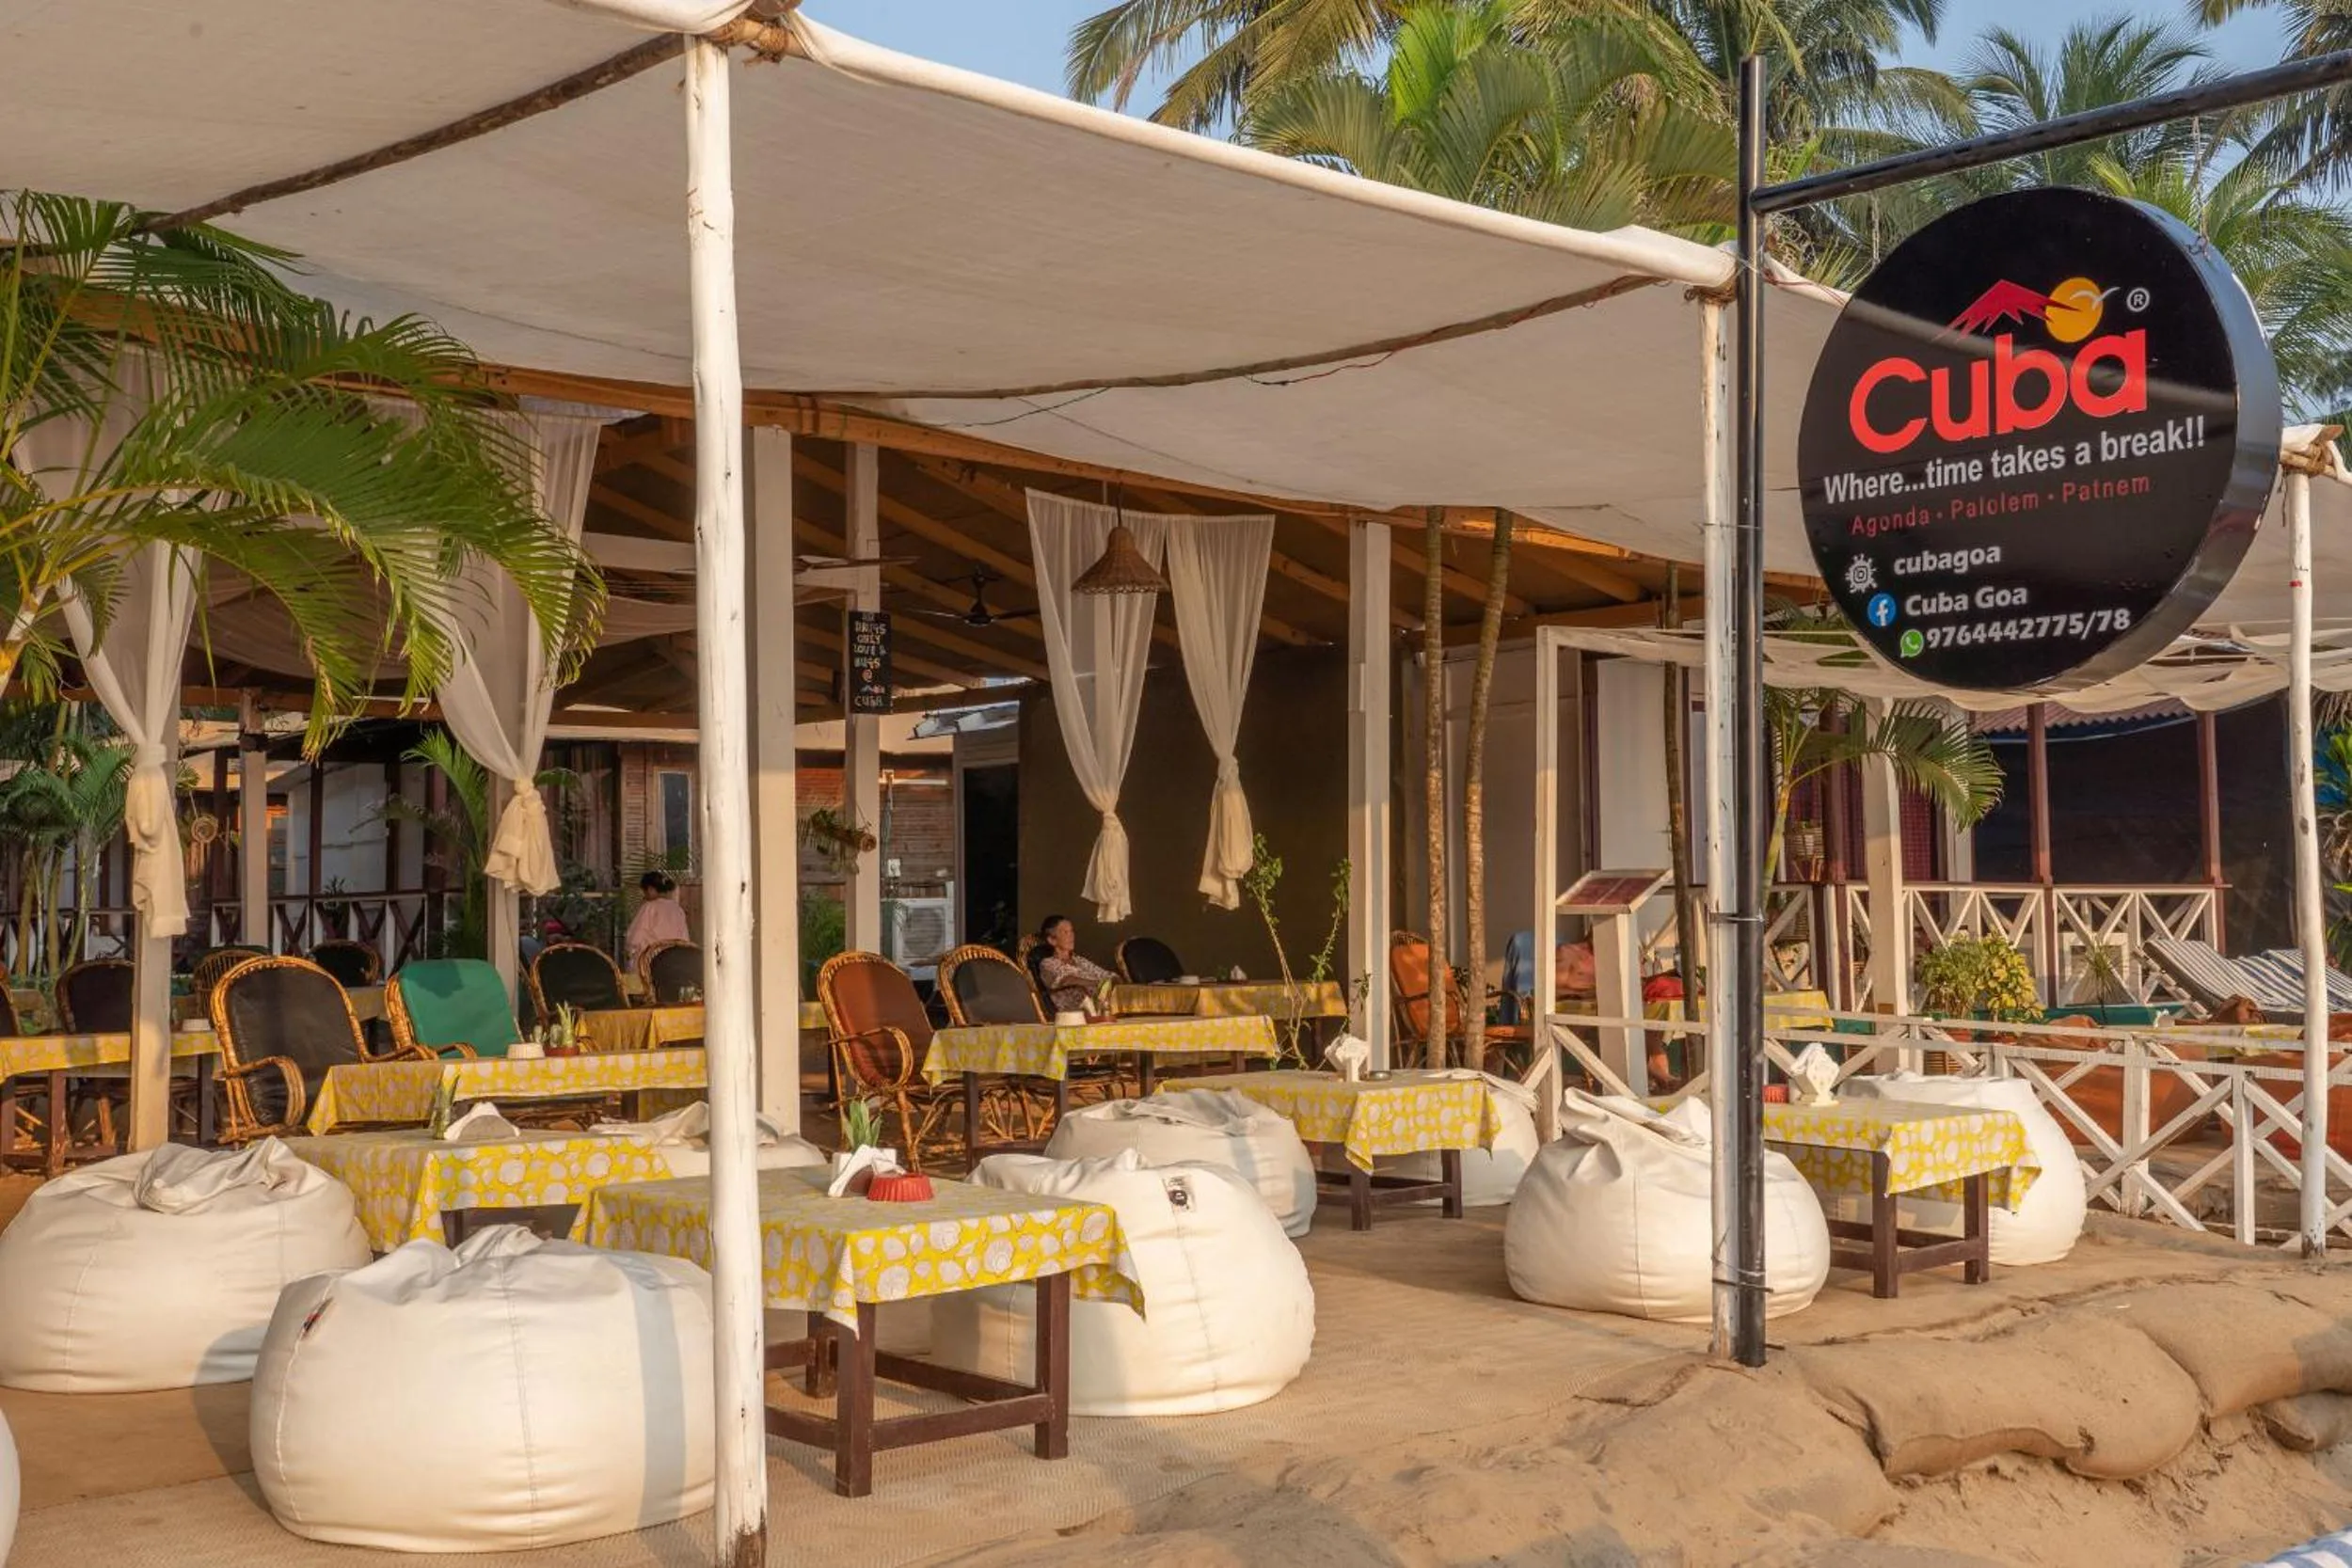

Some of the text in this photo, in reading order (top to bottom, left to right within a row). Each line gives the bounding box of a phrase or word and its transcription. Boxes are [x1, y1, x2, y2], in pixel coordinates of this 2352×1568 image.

[1850, 329, 2147, 452] Cuba
[1990, 444, 2066, 479] takes
[2074, 441, 2092, 466] a
[2100, 415, 2204, 462] break!!
[1851, 474, 2151, 539] Agonda Palolem Patnem
[1893, 546, 2001, 576] cubagoa
[1904, 586, 2027, 616] Cuba Goa
[1927, 609, 2131, 648] 9764442775/78
